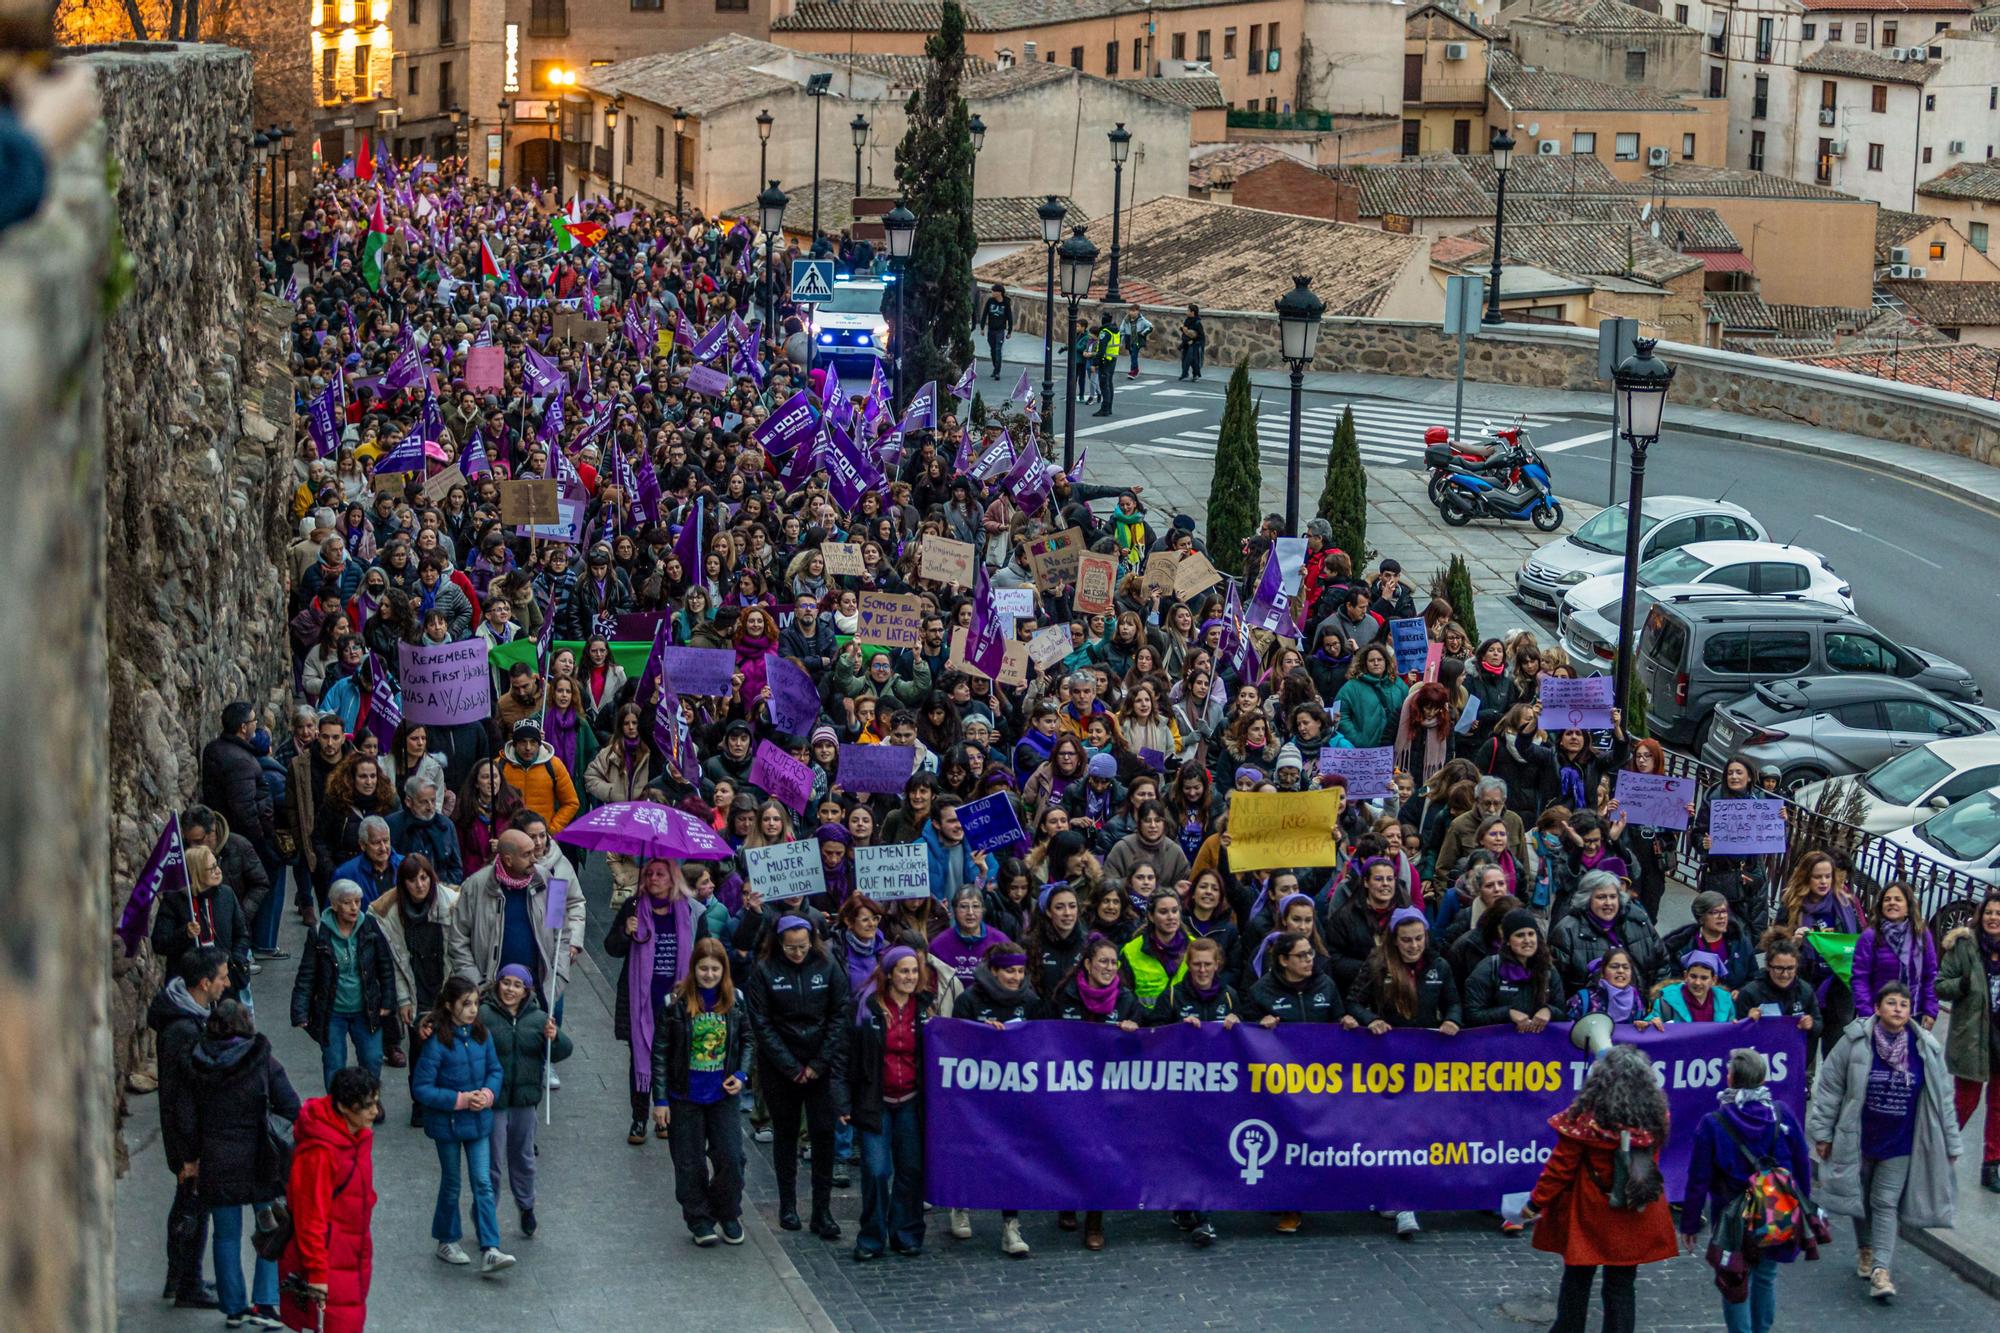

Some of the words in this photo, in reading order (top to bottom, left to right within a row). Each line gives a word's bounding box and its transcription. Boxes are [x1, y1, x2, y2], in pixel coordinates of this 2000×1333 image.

[862, 595, 897, 612] SOMOS
[876, 613, 887, 625] DE
[889, 615, 902, 625] LAS
[871, 627, 881, 638] NO
[886, 626, 917, 641] LATEN
[402, 667, 429, 685] YOUR
[432, 670, 460, 684] FIRST
[403, 688, 424, 703] WAS
[427, 693, 438, 706] A
[440, 686, 489, 716] WOMAN
[768, 745, 806, 782] MUJERES
[842, 779, 907, 792] MATANDO
[964, 815, 991, 831] VISTO
[1281, 813, 1310, 829] NO
[749, 848, 771, 866] QUE
[786, 841, 811, 855] SER
[859, 848, 875, 861] TU
[879, 845, 922, 859] MENTE
[767, 857, 804, 873] MUJER
[753, 874, 767, 886] NO
[770, 872, 787, 882] NOS
[789, 866, 820, 880] CUESTE
[859, 876, 879, 890] QUE
[883, 875, 896, 888] MI
[899, 873, 928, 888] FALDA
[766, 887, 780, 896] LA
[790, 880, 812, 891] VIDA
[938, 1057, 1038, 1092] TODAS
[1047, 1060, 1093, 1091] LAS
[1101, 1060, 1239, 1092] MUJERES
[1248, 1063, 1343, 1094] TODOS
[1352, 1063, 1405, 1093] LOS
[1413, 1061, 1562, 1092] DERECHOS
[1673, 1058, 1722, 1088] LOS
[1285, 1140, 1552, 1166] Plataforma8MToledo
